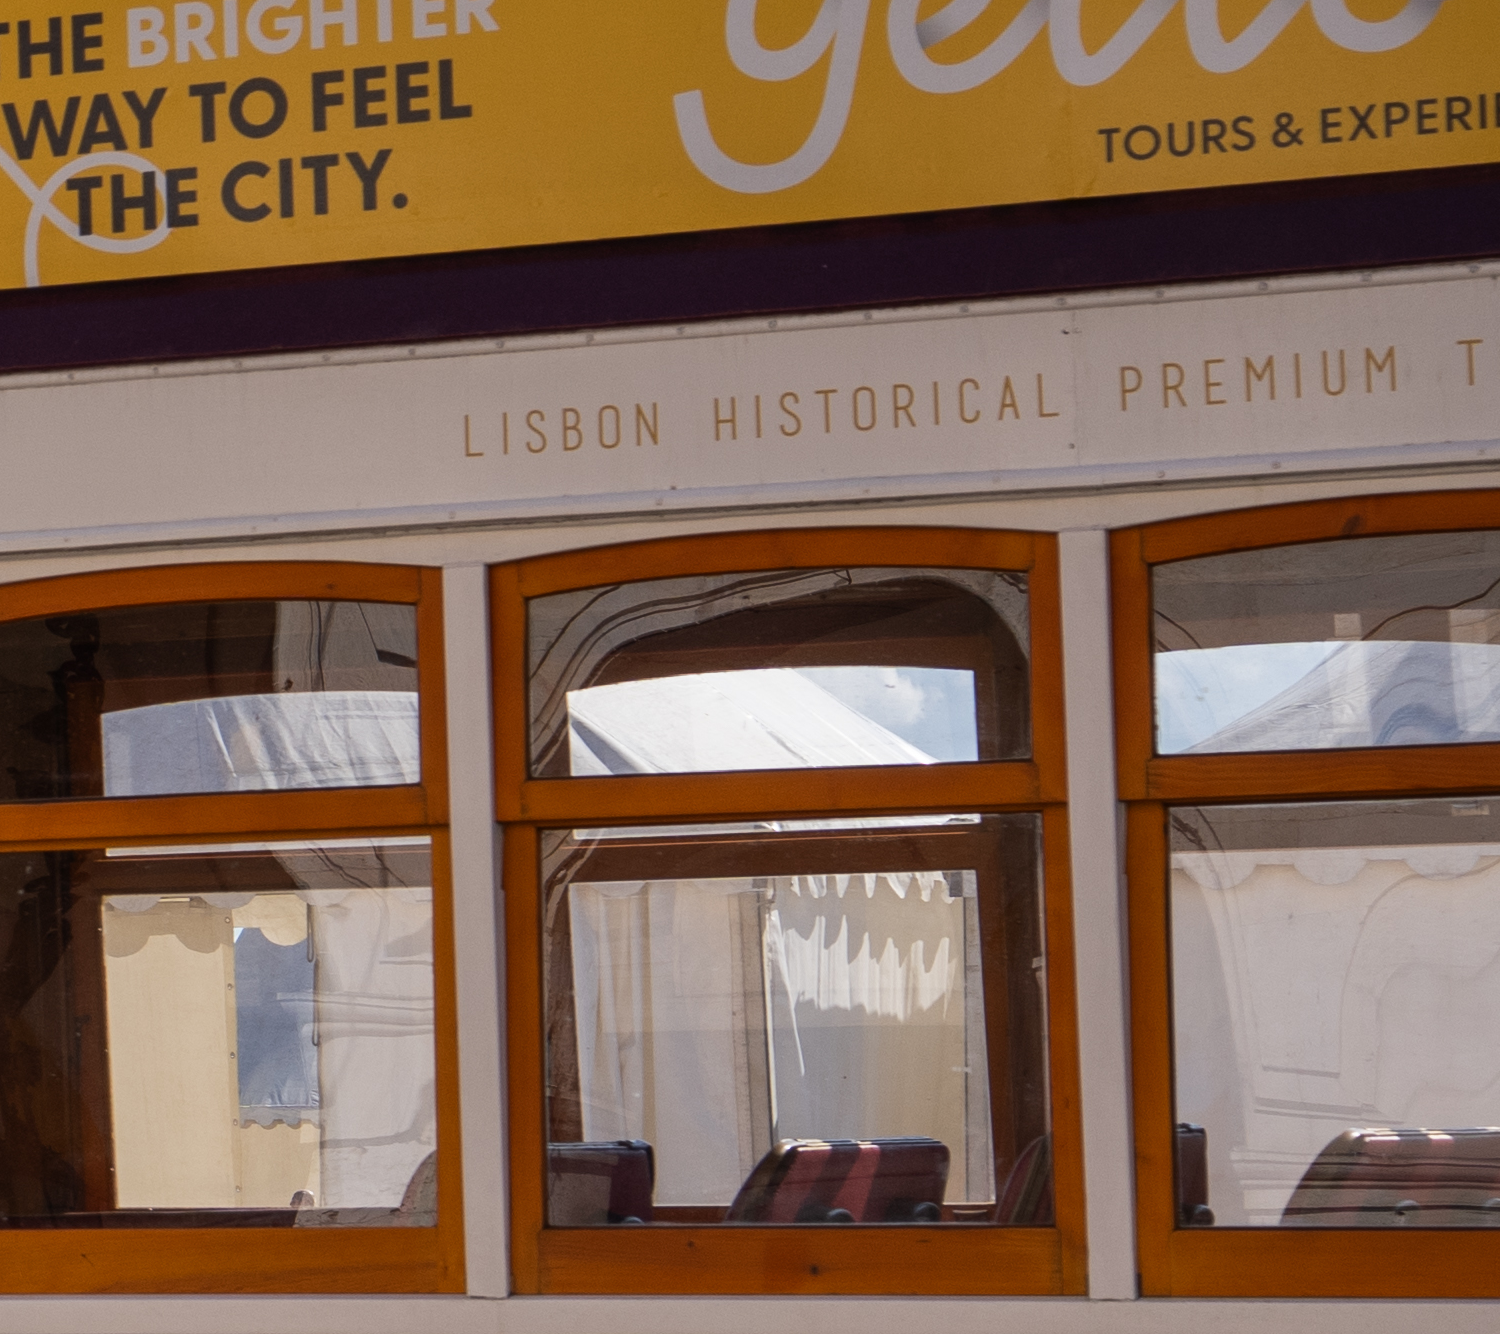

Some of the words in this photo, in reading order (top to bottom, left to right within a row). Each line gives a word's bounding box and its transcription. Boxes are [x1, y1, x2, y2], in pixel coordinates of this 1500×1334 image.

[1, 86, 169, 161] WAY
[189, 76, 288, 144] TO
[311, 58, 473, 133] FEEL
[1098, 115, 1256, 163] TOURS
[1271, 111, 1304, 149] &
[65, 166, 200, 237] THE
[221, 148, 409, 223] CITY.
[464, 402, 659, 458] LISBON
[712, 372, 1061, 442] HISTORICAL
[1119, 345, 1397, 412] PREMIUM
